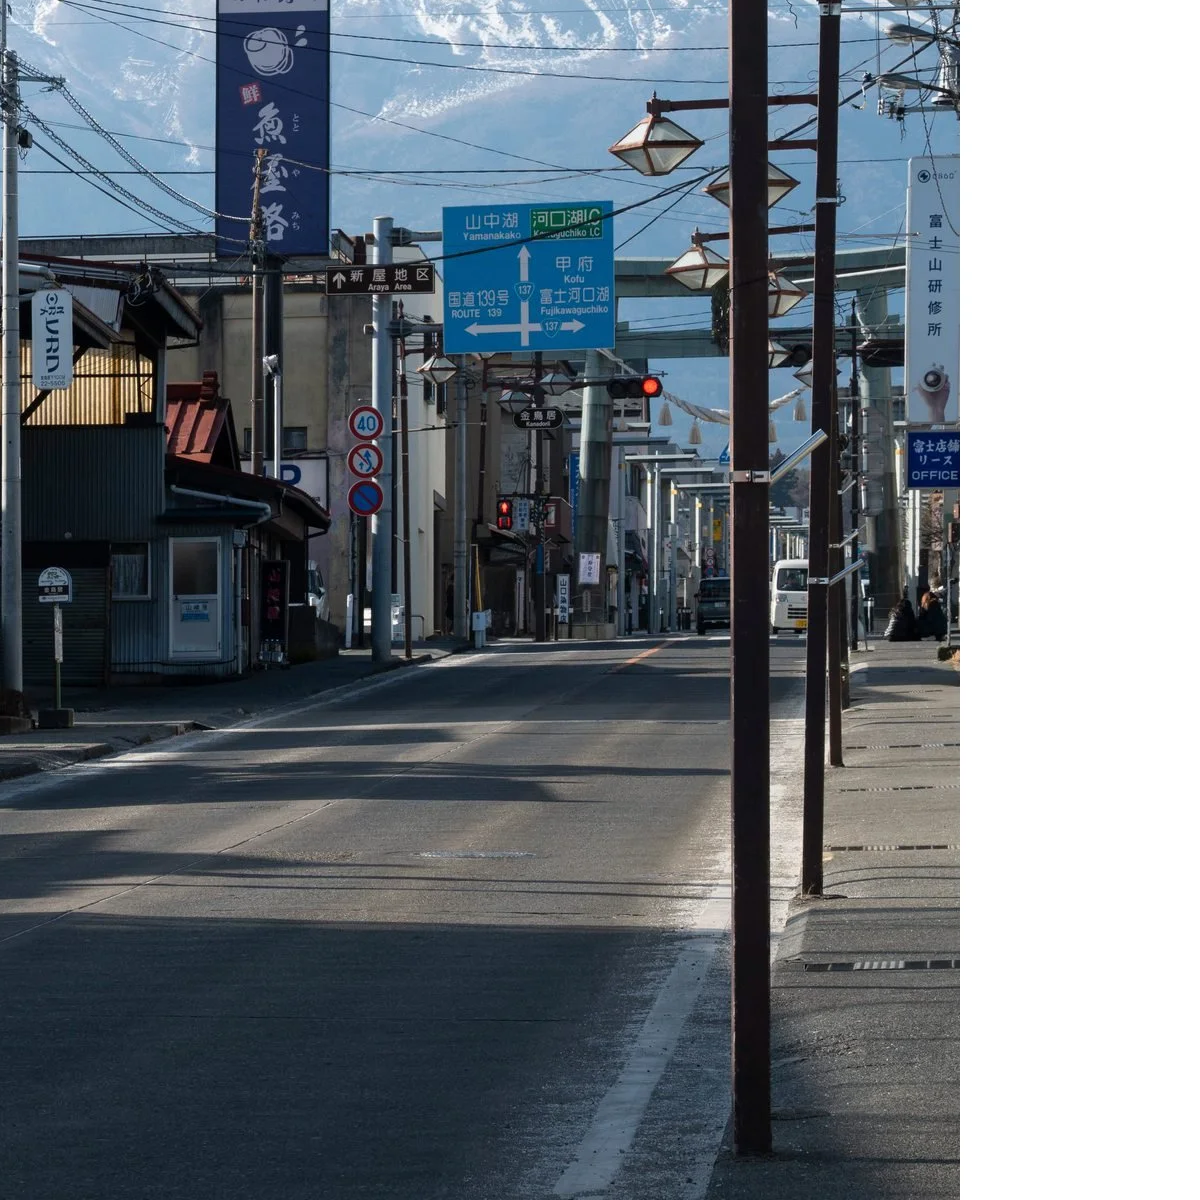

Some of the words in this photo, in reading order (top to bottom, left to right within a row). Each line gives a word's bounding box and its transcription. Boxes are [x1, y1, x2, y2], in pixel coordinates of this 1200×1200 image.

[465, 212, 519, 230] 山中湖
[463, 231, 522, 241] Yamanakako
[555, 255, 594, 272] 甲府
[350, 267, 430, 282] 新屋地区
[563, 274, 585, 284] Kofu
[927, 214, 943, 337] 富士山研修所
[367, 283, 390, 292] Araya
[394, 282, 412, 291] Area
[518, 285, 531, 294] 137
[448, 289, 510, 308] 国道139号
[539, 286, 609, 305] 富士河口湖
[451, 308, 481, 319] ROUTE
[487, 308, 502, 318] 139
[540, 305, 609, 316] Fujikawaguchiko
[544, 321, 558, 331] 137
[357, 415, 376, 432] 40
[913, 439, 960, 453] 富士店舗
[919, 455, 953, 465] リース
[911, 470, 959, 480] OFFICE
